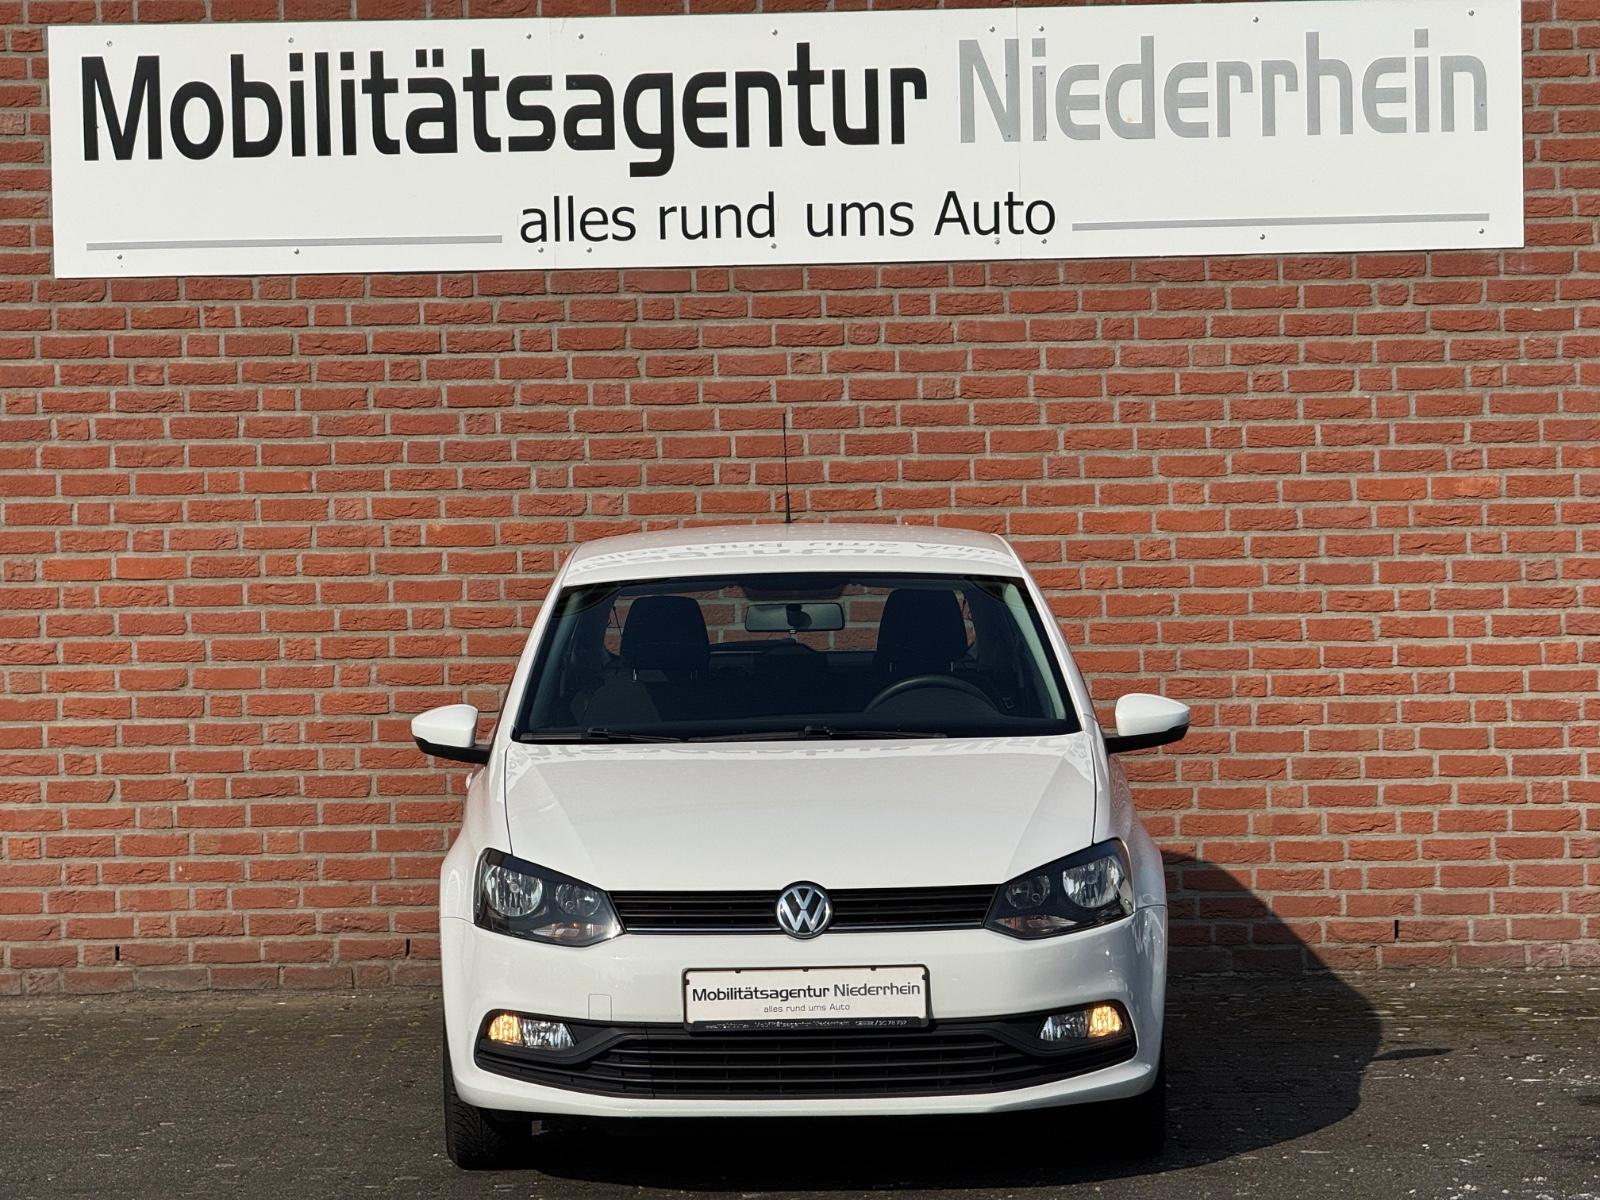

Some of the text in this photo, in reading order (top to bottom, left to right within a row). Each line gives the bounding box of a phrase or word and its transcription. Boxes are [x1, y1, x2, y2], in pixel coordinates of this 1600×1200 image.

[82, 29, 1488, 177] Mobilitätsagentur Niederrhein
[521, 191, 1056, 243] alles rund ums Auto
[780, 885, 827, 934] VW
[692, 982, 920, 1002] Mobilitätsagentur Niederrhein
[763, 1005, 783, 1013] alles
[786, 1004, 806, 1012] rund
[829, 1003, 850, 1011] Auto
